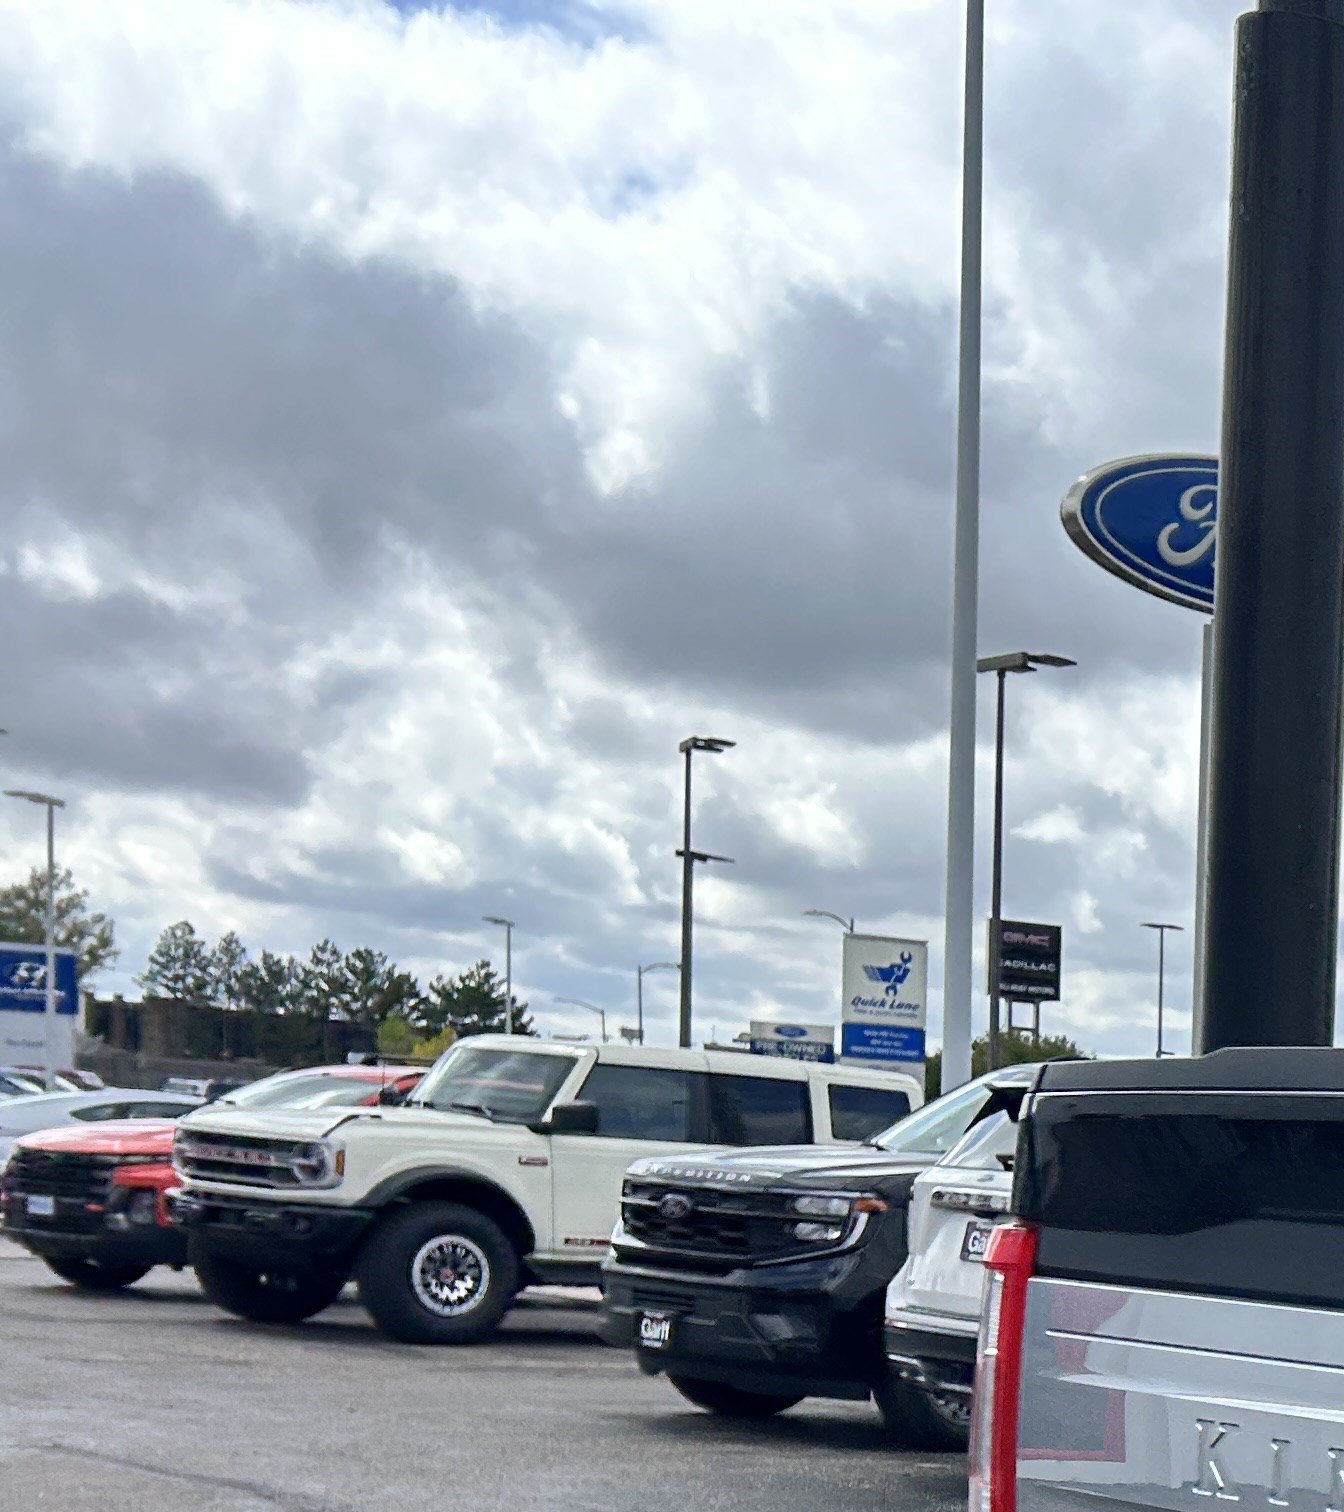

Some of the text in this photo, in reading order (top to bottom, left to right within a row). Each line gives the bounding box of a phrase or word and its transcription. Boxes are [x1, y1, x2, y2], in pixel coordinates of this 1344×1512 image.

[851, 996, 921, 1011] Quick Lane
[634, 1162, 751, 1181] PEDITION
